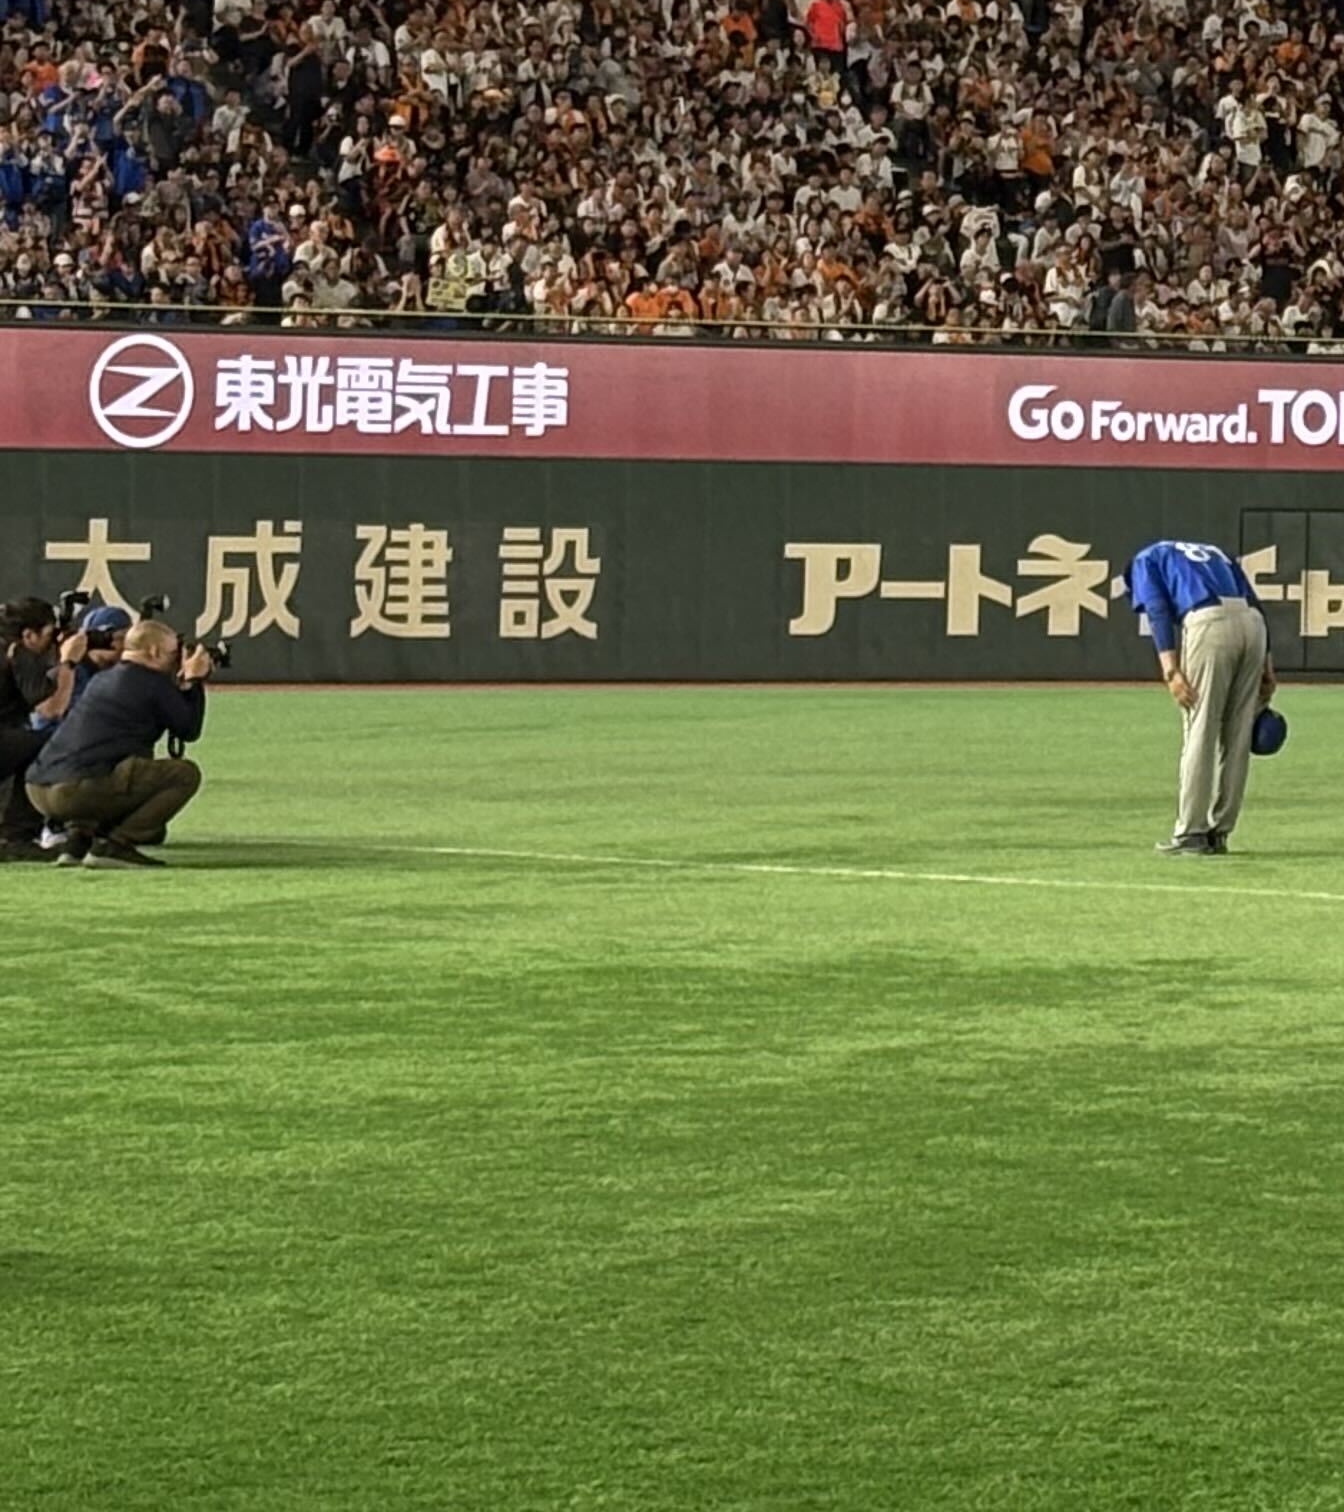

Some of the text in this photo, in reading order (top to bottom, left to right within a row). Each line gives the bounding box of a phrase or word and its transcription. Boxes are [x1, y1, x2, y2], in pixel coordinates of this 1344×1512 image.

[214, 353, 569, 437] 東光電気工事
[1091, 399, 1257, 445] Forward.
[45, 518, 602, 640] 大成建設
